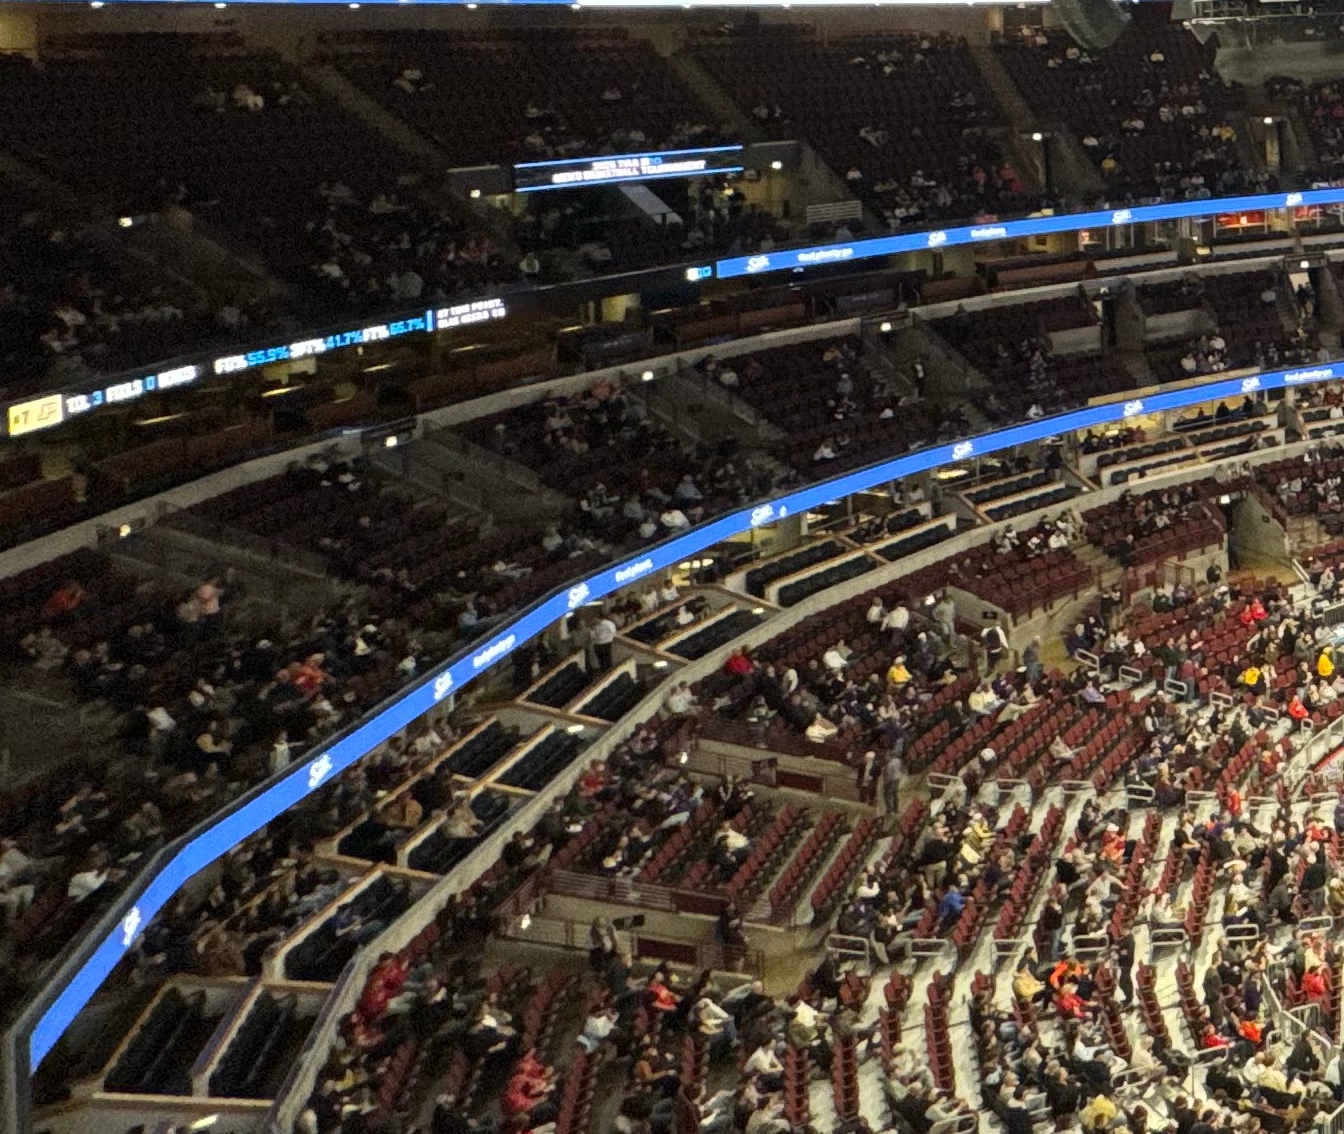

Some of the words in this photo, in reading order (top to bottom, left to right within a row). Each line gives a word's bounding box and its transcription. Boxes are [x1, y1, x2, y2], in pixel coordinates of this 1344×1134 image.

[247, 346, 290, 366] 55.9%
[325, 330, 364, 349] 41.7%
[93, 391, 103, 406] 3
